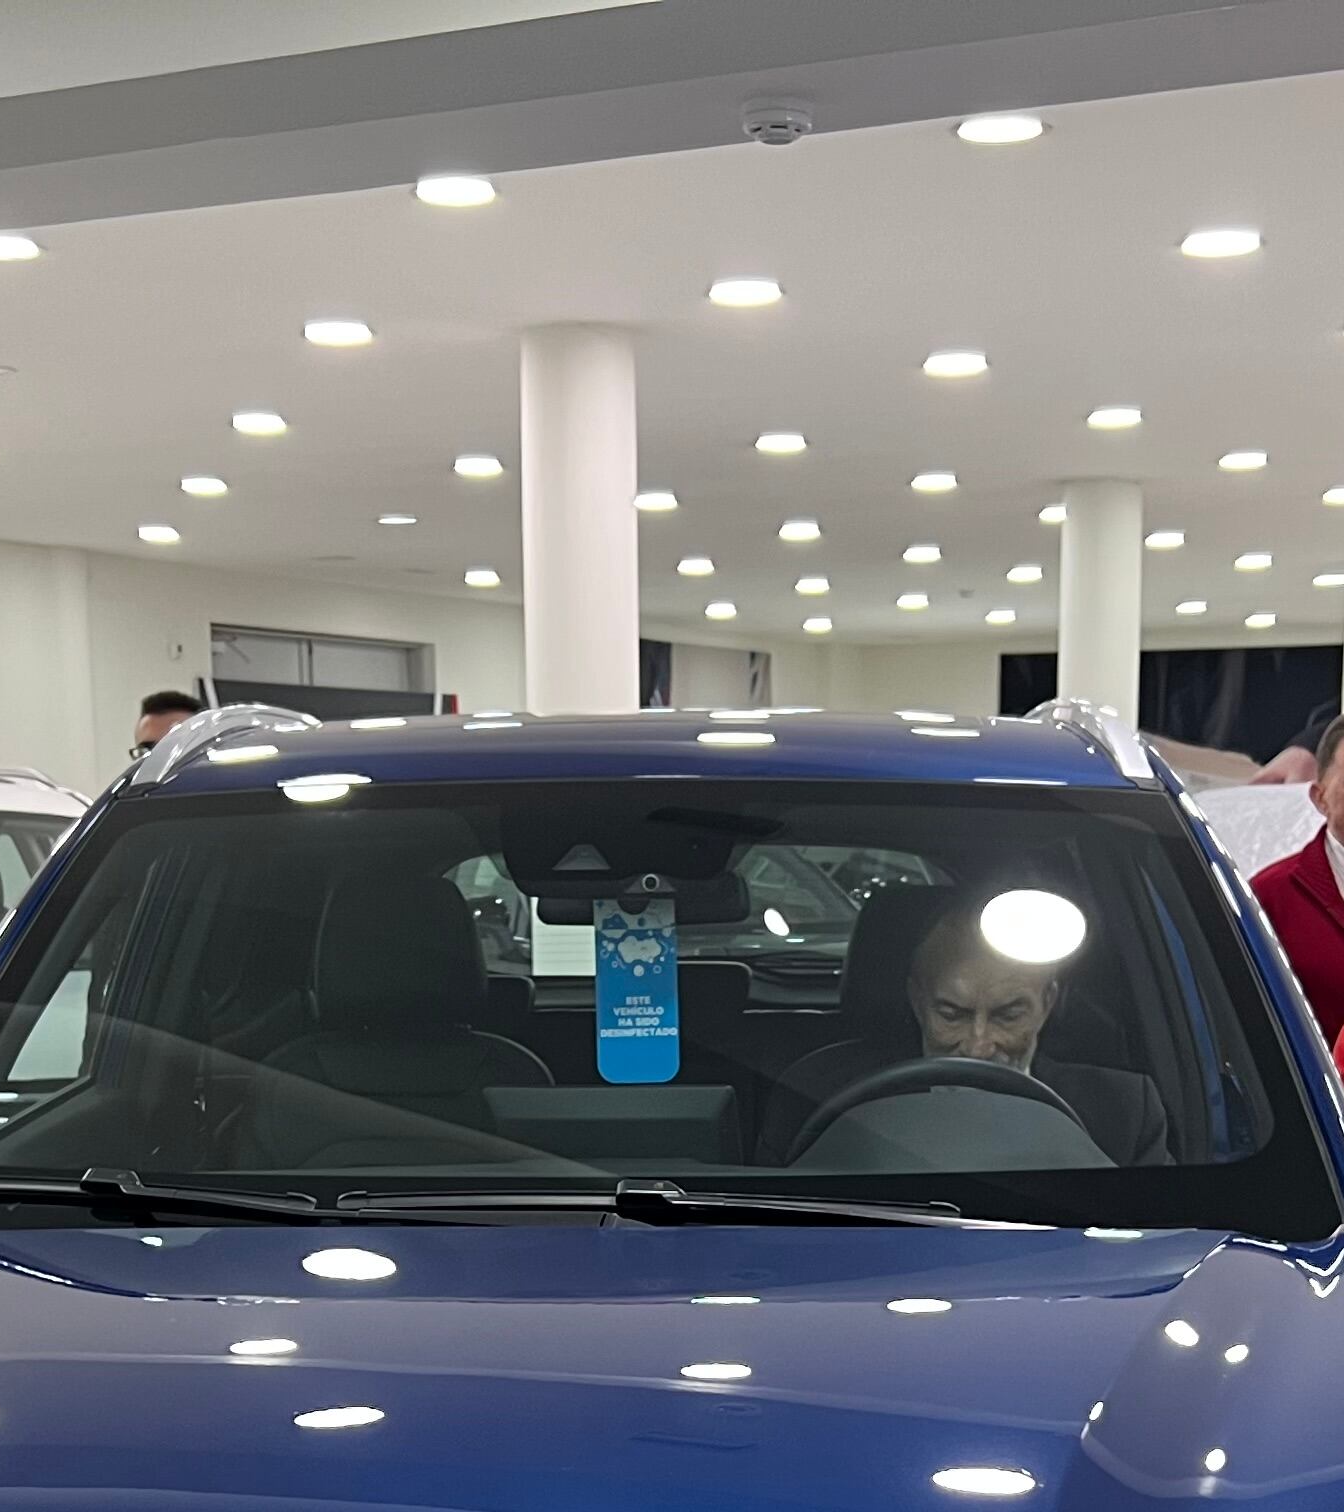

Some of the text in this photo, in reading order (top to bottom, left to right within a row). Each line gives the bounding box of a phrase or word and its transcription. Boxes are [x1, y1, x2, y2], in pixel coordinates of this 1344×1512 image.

[625, 996, 651, 1005] ESTE
[617, 1016, 660, 1026] HA SIDO
[600, 1026, 678, 1038] DESINFECTADO
